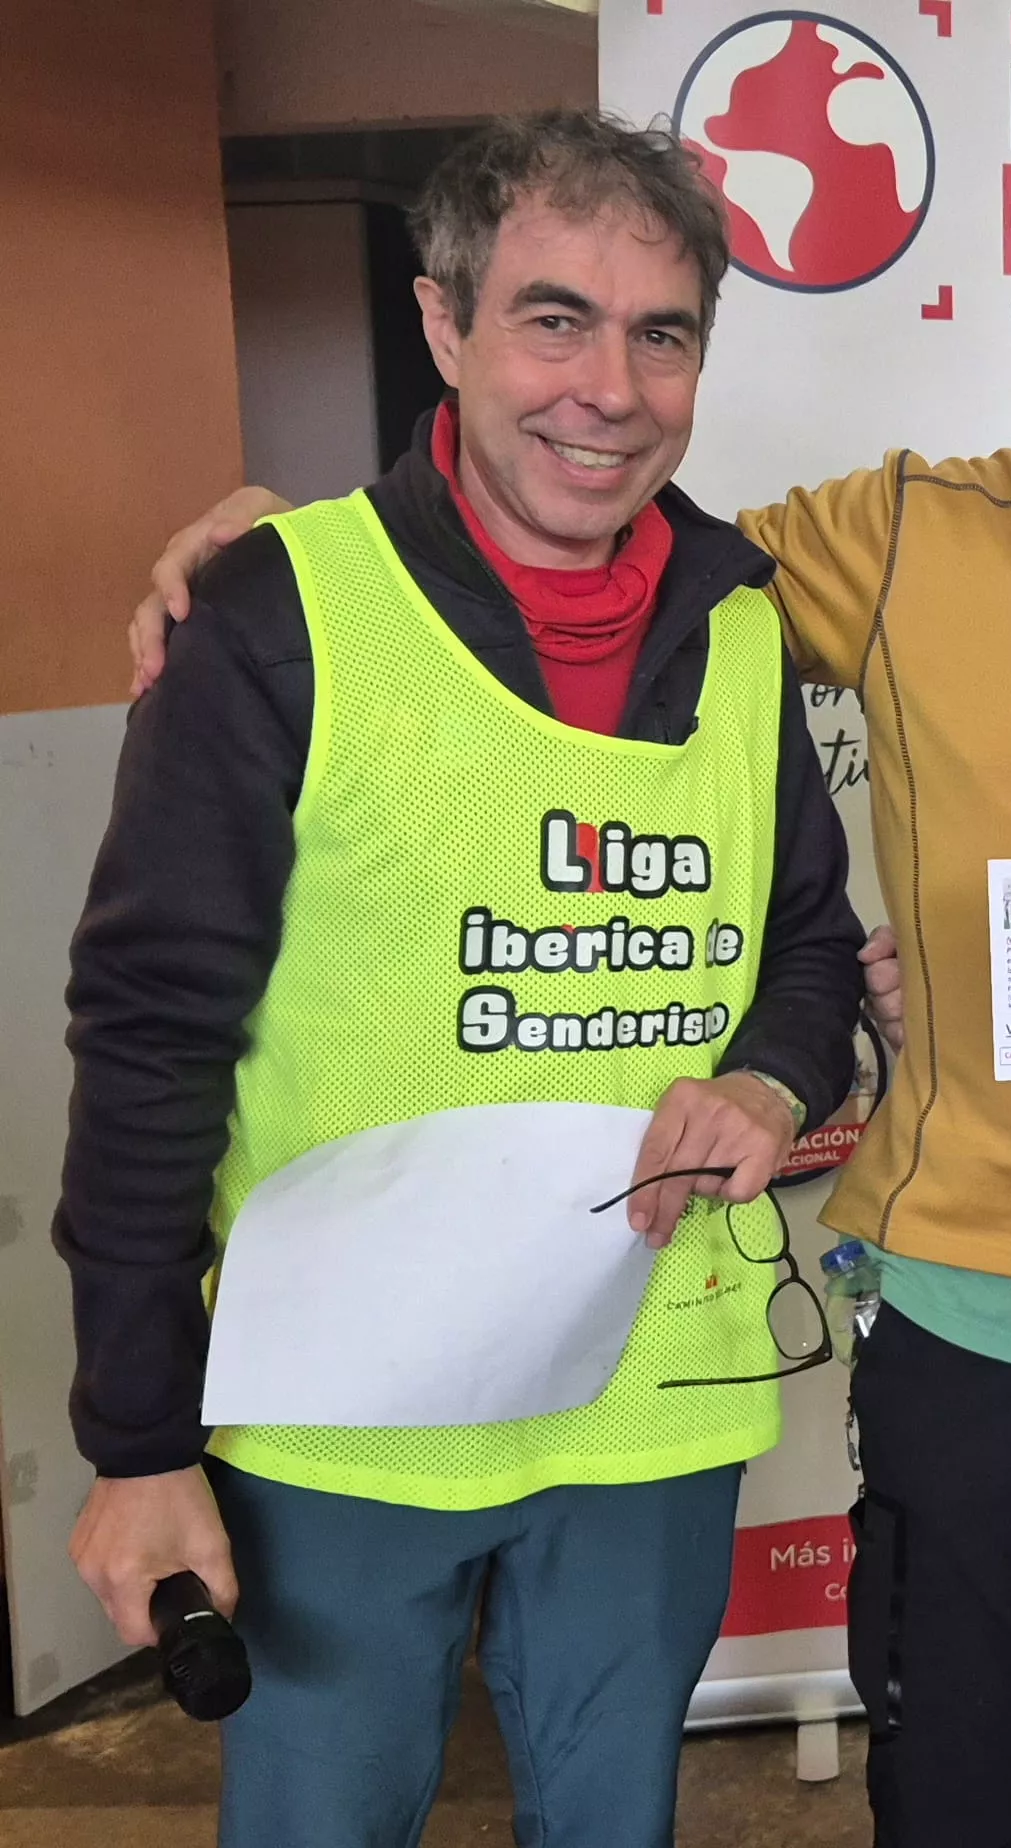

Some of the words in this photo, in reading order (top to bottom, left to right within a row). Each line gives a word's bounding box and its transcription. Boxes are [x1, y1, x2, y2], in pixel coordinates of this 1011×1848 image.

[540, 808, 711, 899] Liga
[459, 905, 694, 975] iberica
[770, 1540, 831, 1571] Más
